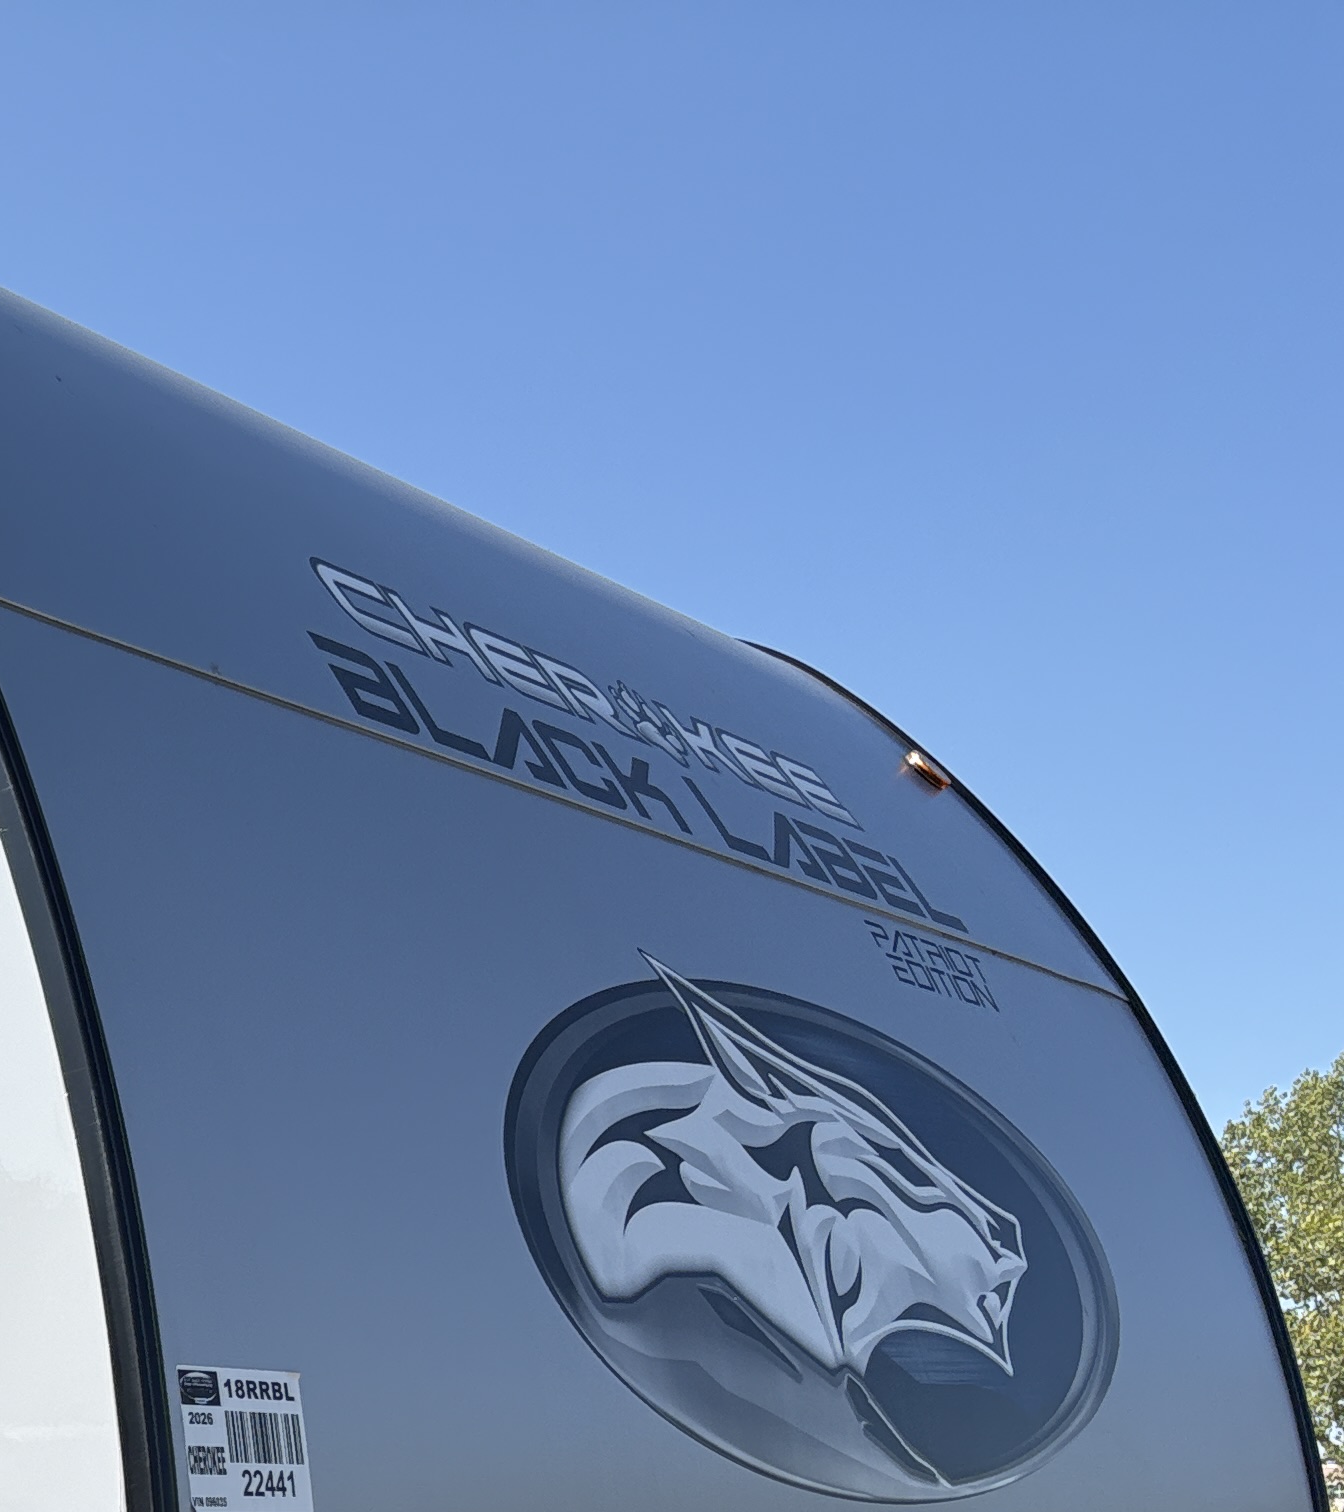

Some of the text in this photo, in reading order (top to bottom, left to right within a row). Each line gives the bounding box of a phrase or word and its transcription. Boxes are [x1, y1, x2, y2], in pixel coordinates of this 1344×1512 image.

[306, 630, 968, 934] BLACK LABEL
[864, 920, 984, 977] PATRIOT
[887, 953, 1000, 1013] EDITION
[223, 1378, 296, 1401] 18RRBL
[188, 1411, 214, 1425] 2026
[242, 1470, 297, 1497] 22441
